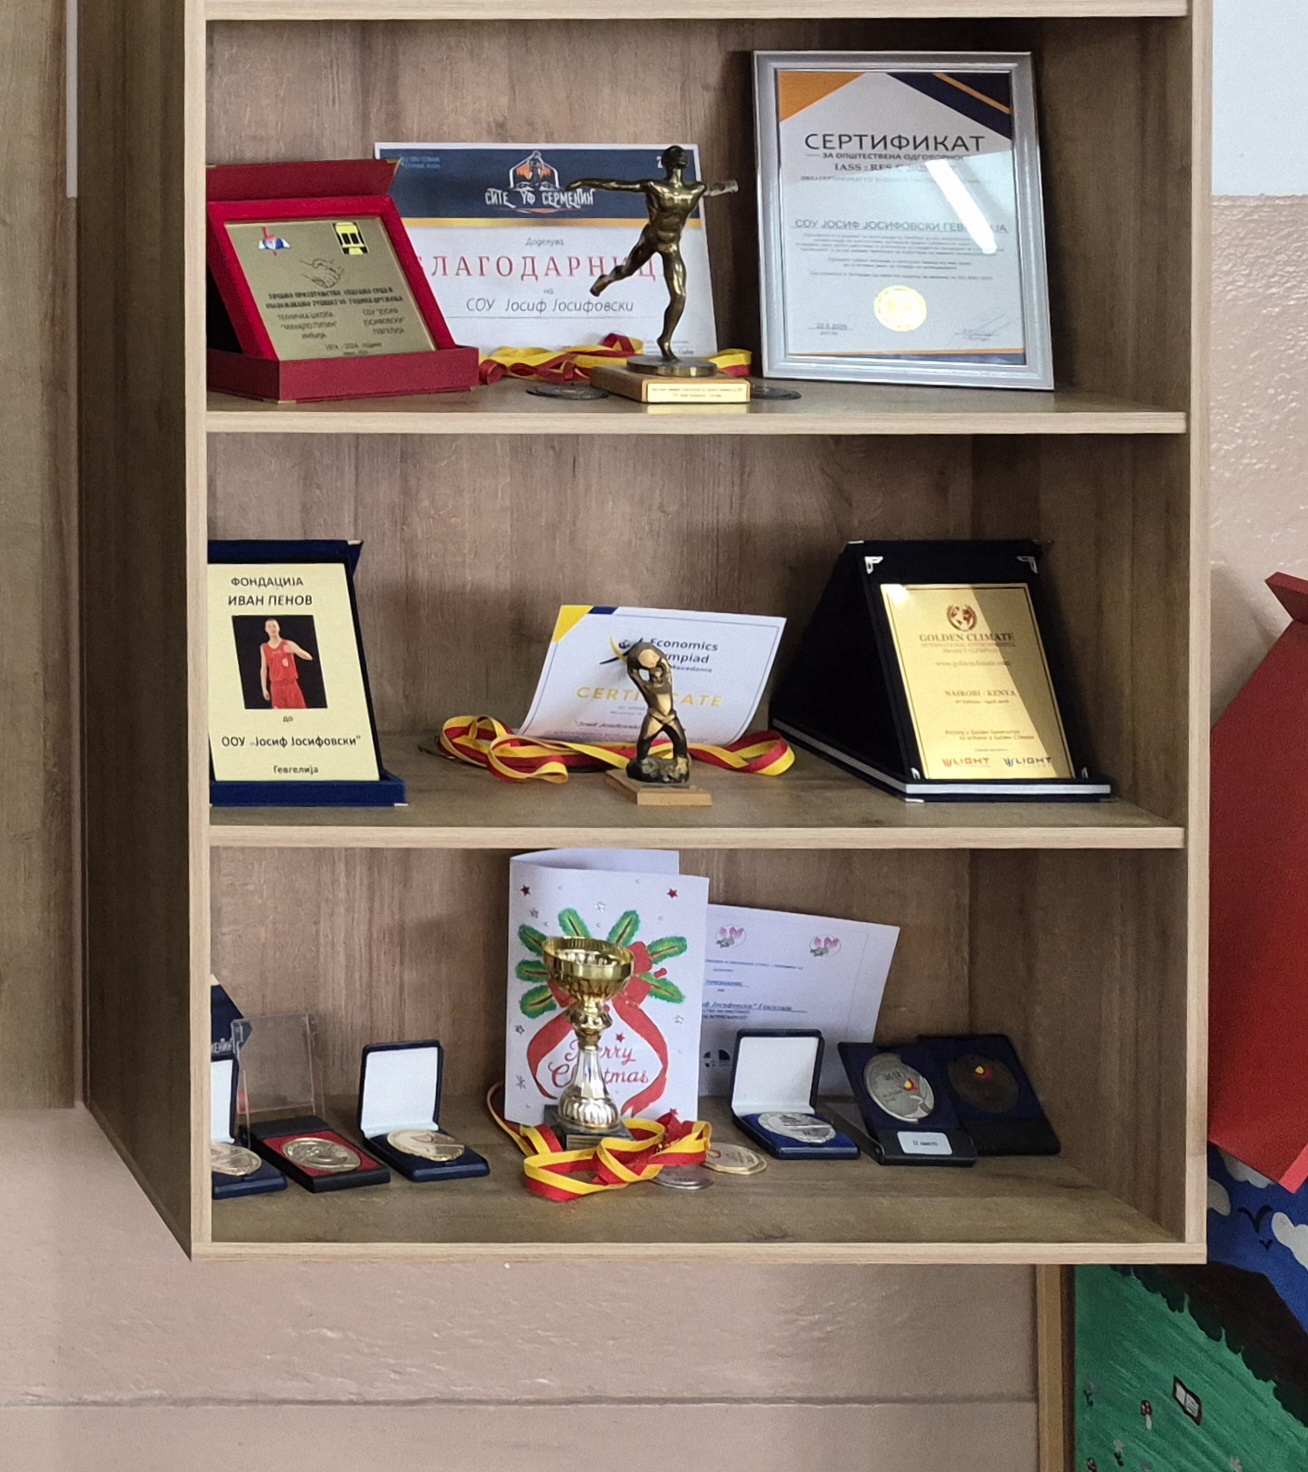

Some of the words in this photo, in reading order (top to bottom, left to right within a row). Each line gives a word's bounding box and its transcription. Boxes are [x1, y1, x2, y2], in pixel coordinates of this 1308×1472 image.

[805, 133, 986, 153] СЕРТИФИКАТ
[795, 219, 818, 229] СОУ
[821, 220, 860, 230] ЈОСИФ
[863, 220, 940, 232] ЈОСИФОВСКИ
[466, 298, 495, 312] СОУ
[504, 298, 547, 314] Јосиф
[551, 298, 634, 314] Јосифовски
[231, 576, 304, 588] ФОНДАЦИЈА
[228, 595, 264, 606] ИВАН
[269, 595, 313, 606] ПЕНОВ
[919, 633, 964, 642] GOLDEN
[966, 633, 1014, 641] CLIMATE
[650, 637, 719, 652] Economics
[221, 737, 245, 747] ООУ
[273, 765, 319, 777] Гевгелија
